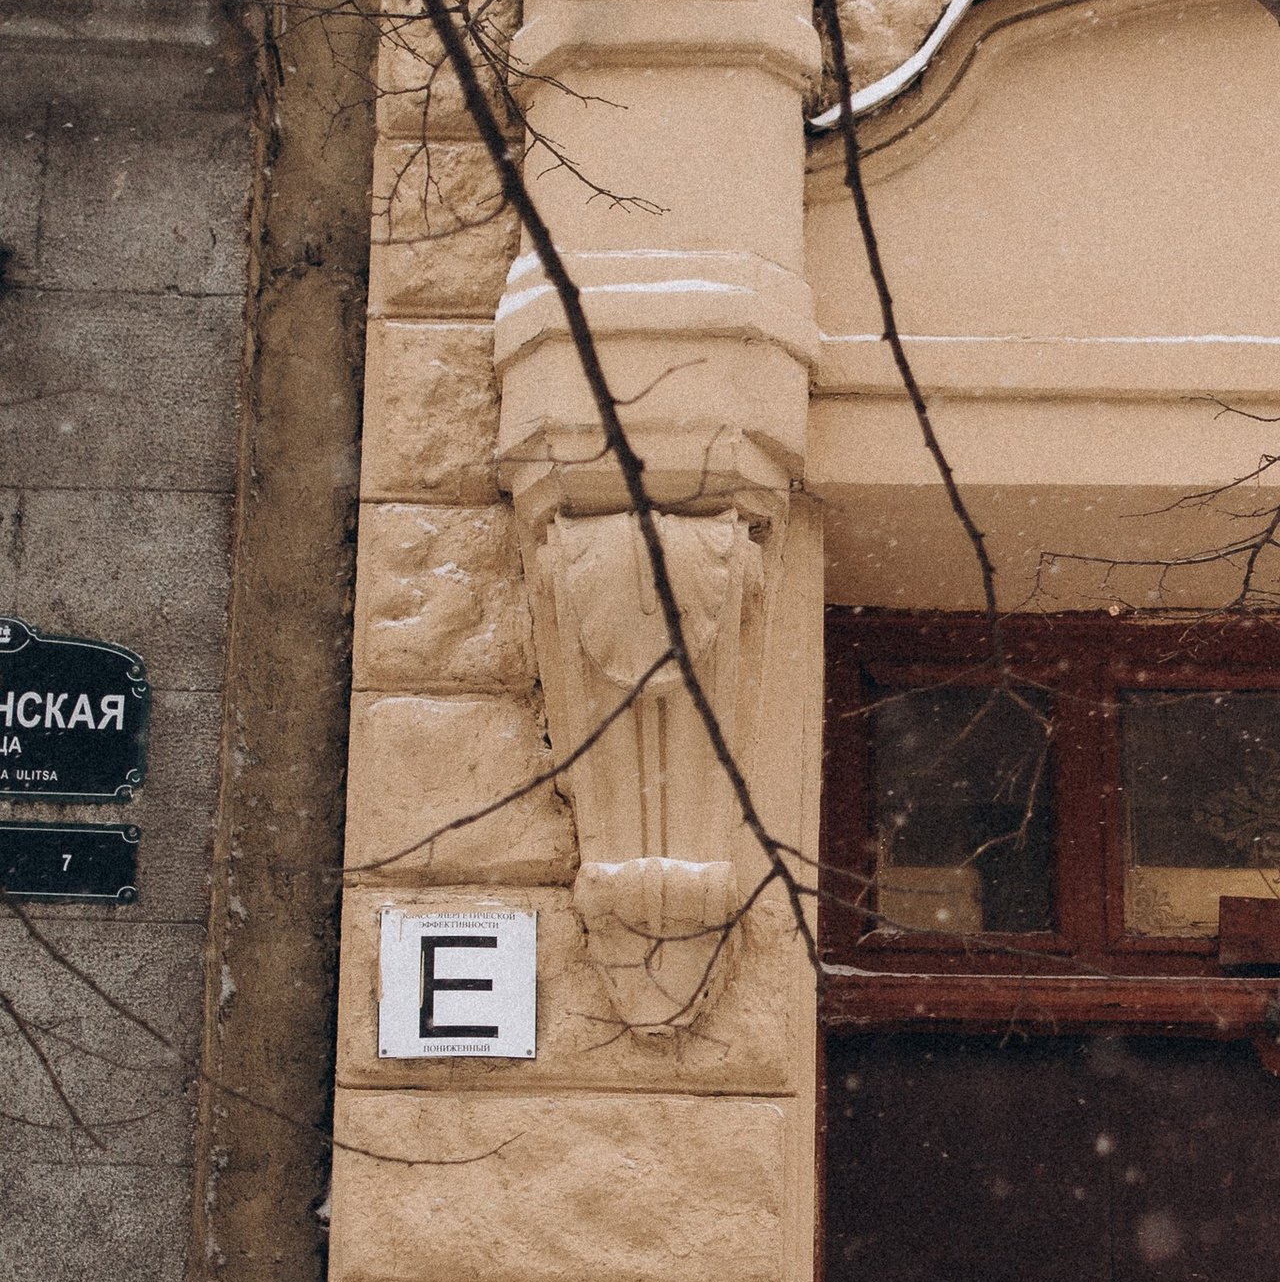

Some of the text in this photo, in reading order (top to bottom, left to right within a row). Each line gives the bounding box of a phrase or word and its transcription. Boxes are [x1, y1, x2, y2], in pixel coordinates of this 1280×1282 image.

[0, 691, 125, 730] НСКАЯ
[16, 770, 58, 781] ULITSA
[62, 854, 72, 871] 7
[419, 936, 499, 1038] Е
[423, 1044, 490, 1052] ПОНИЖЕННЫЙ
